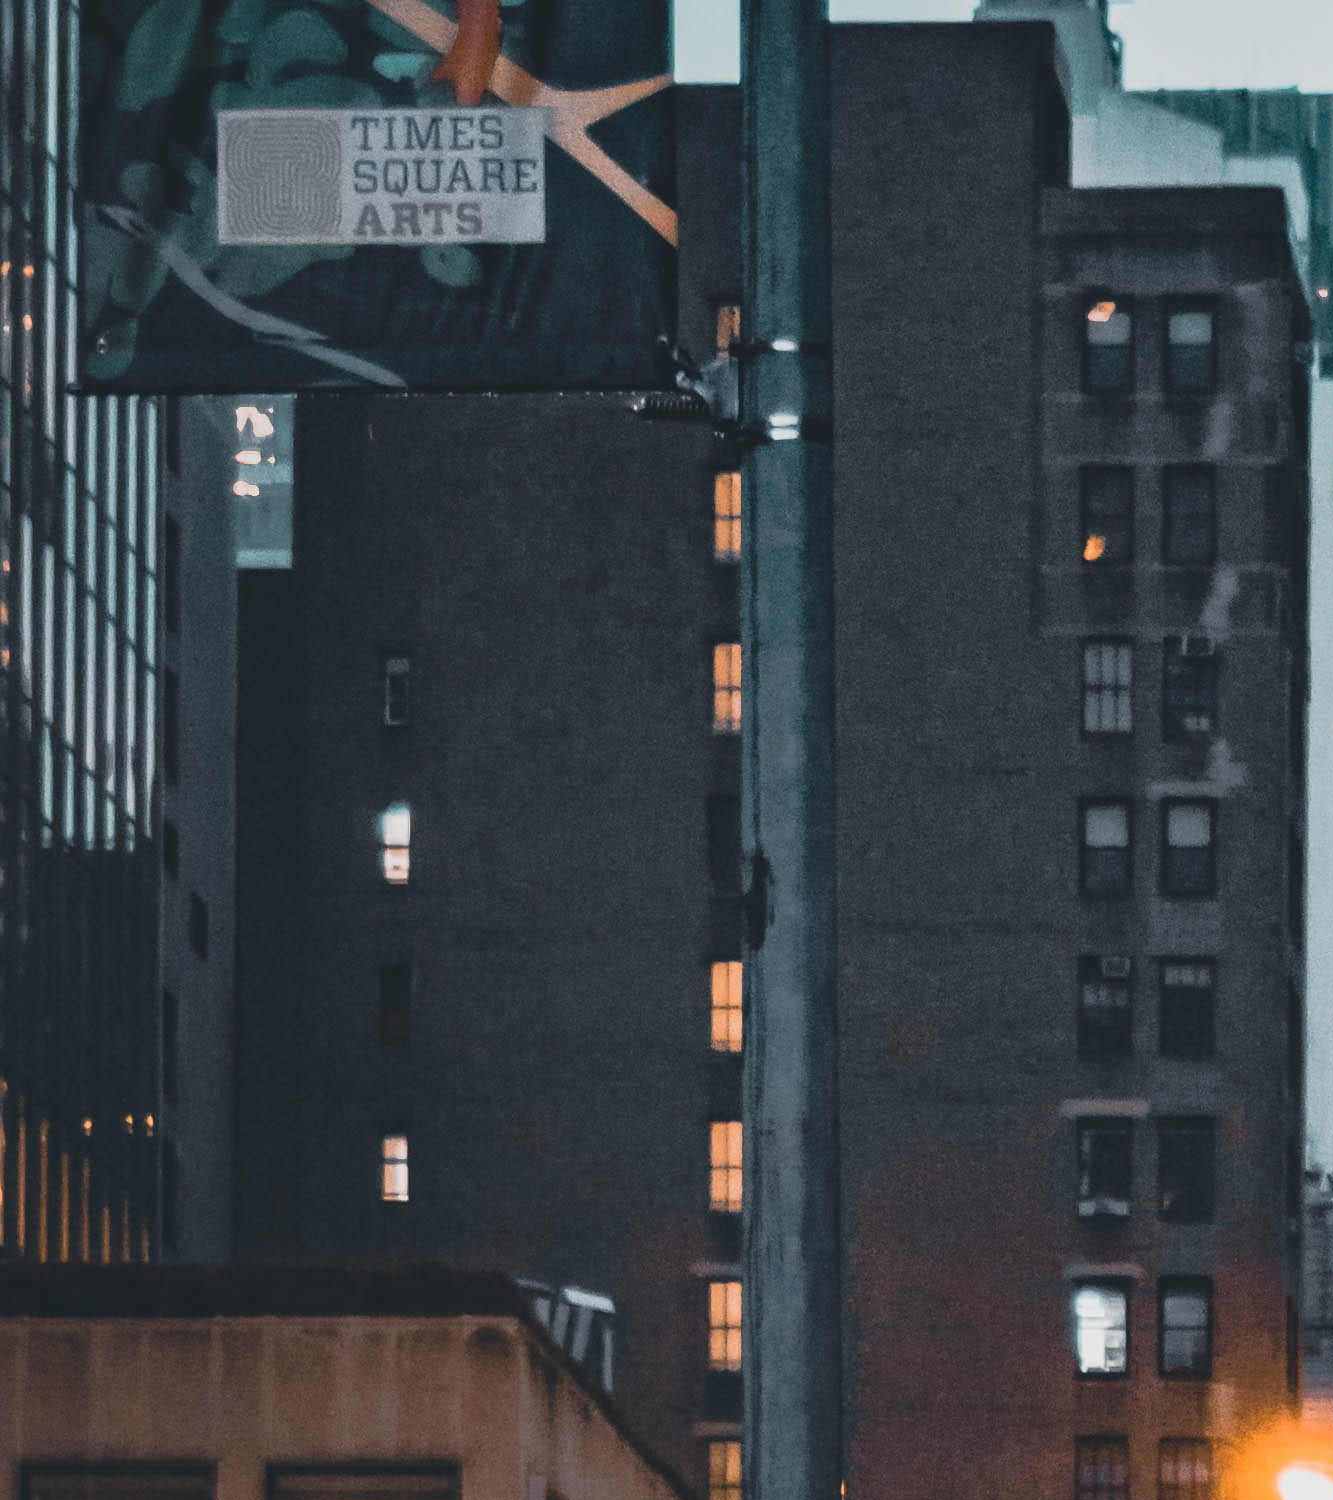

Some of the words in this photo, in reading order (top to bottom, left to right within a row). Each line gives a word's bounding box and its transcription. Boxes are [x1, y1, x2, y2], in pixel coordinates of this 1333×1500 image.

[351, 117, 504, 151] TIMES
[353, 159, 538, 195] SQUARE
[353, 203, 483, 236] ARTS
